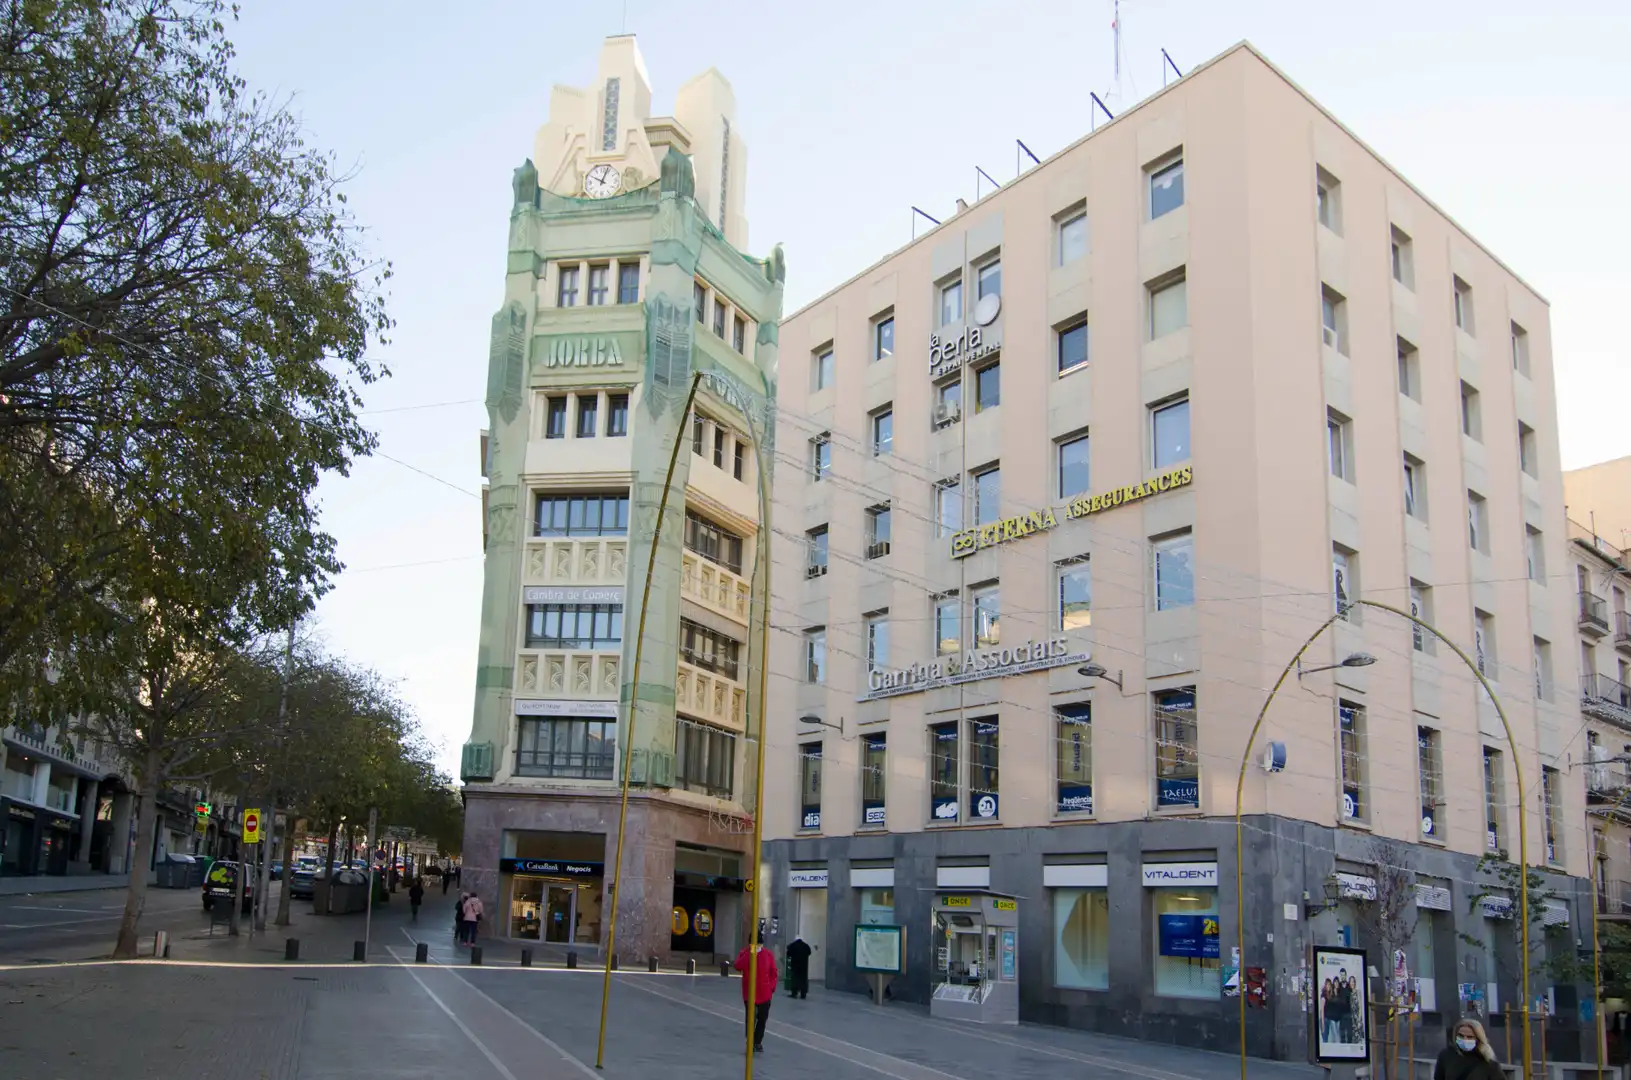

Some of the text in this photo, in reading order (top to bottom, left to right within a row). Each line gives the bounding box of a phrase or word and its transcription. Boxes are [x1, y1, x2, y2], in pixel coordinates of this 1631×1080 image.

[545, 338, 624, 368] JORBA
[929, 326, 982, 375] perla
[979, 465, 1192, 549] ETERNA ASSEGURANCES
[526, 589, 621, 603] Cambra de Comerç
[869, 661, 942, 691] Garriga
[963, 636, 1068, 672] Associats
[1163, 787, 1197, 798] TAELUS
[526, 862, 592, 873] CaixaBank Negocis
[1145, 870, 1215, 879] VITALDENT
[1000, 902, 1014, 910] ONCE
